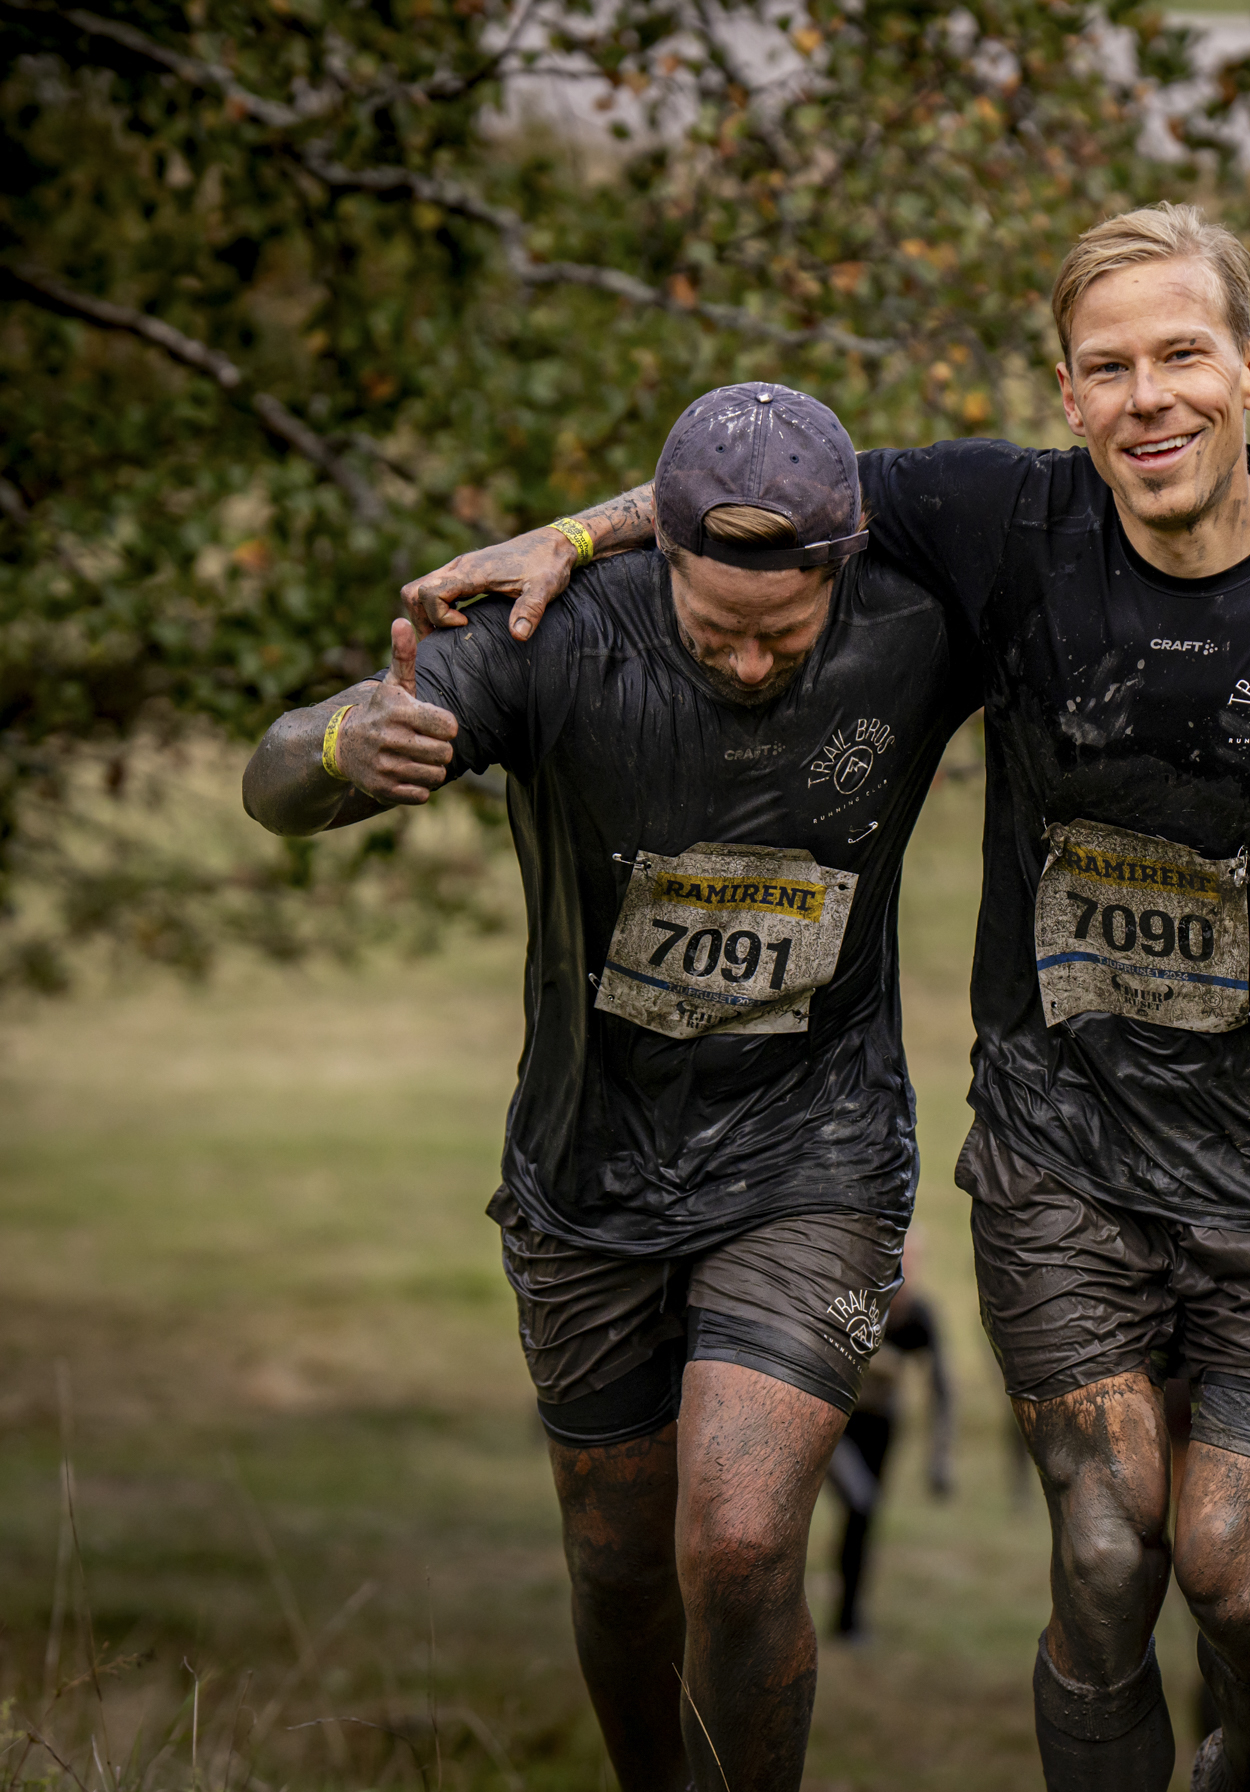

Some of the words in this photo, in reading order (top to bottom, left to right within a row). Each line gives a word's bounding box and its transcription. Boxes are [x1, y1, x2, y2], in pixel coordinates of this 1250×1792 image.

[1150, 638, 1203, 652] CRAFT
[724, 744, 772, 761] CRAFT
[807, 728, 851, 789] TRAIL
[855, 718, 895, 754] BROS
[813, 797, 860, 824] RUNNING
[1065, 851, 1211, 893] RAMIRENT
[663, 879, 816, 911] RAMIRENT
[1067, 890, 1214, 962] 7090
[648, 918, 793, 991] 7091
[826, 1289, 868, 1323] TRAIL
